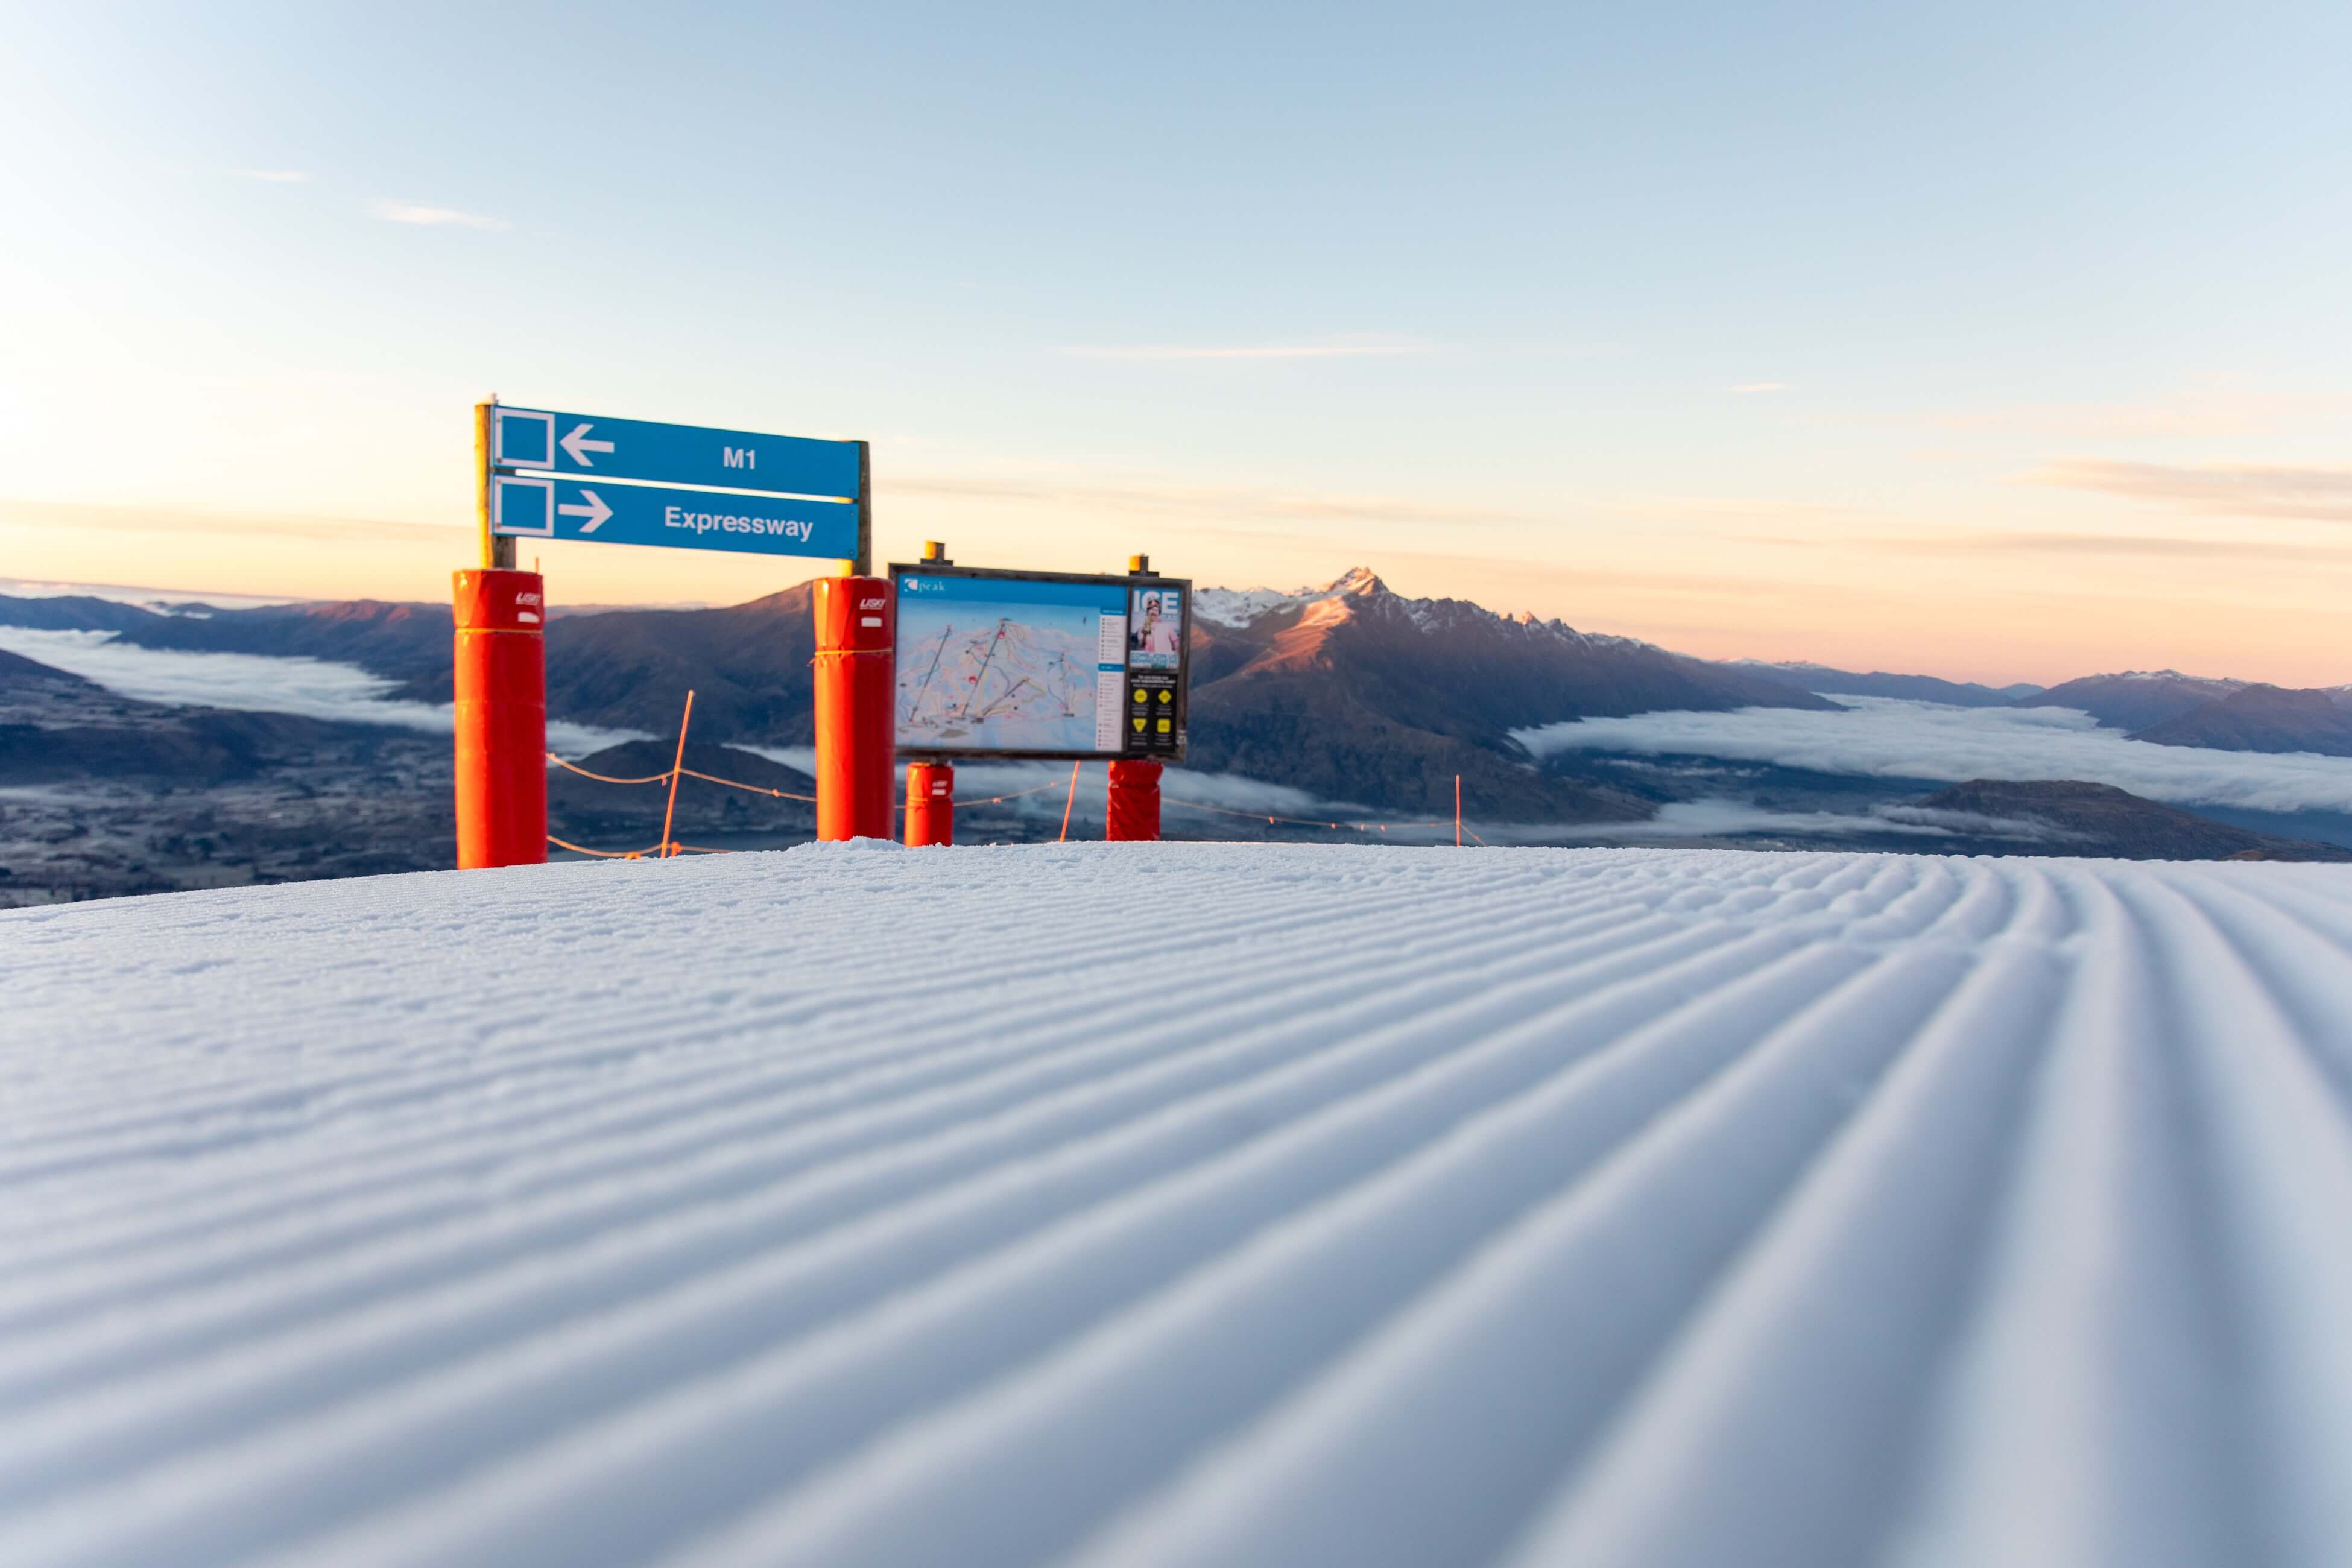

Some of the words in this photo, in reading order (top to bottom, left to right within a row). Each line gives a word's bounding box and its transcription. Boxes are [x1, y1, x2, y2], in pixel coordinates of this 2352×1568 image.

[723, 446, 756, 469] M1
[665, 505, 814, 542] Expressway
[1134, 590, 1178, 614] ICE
